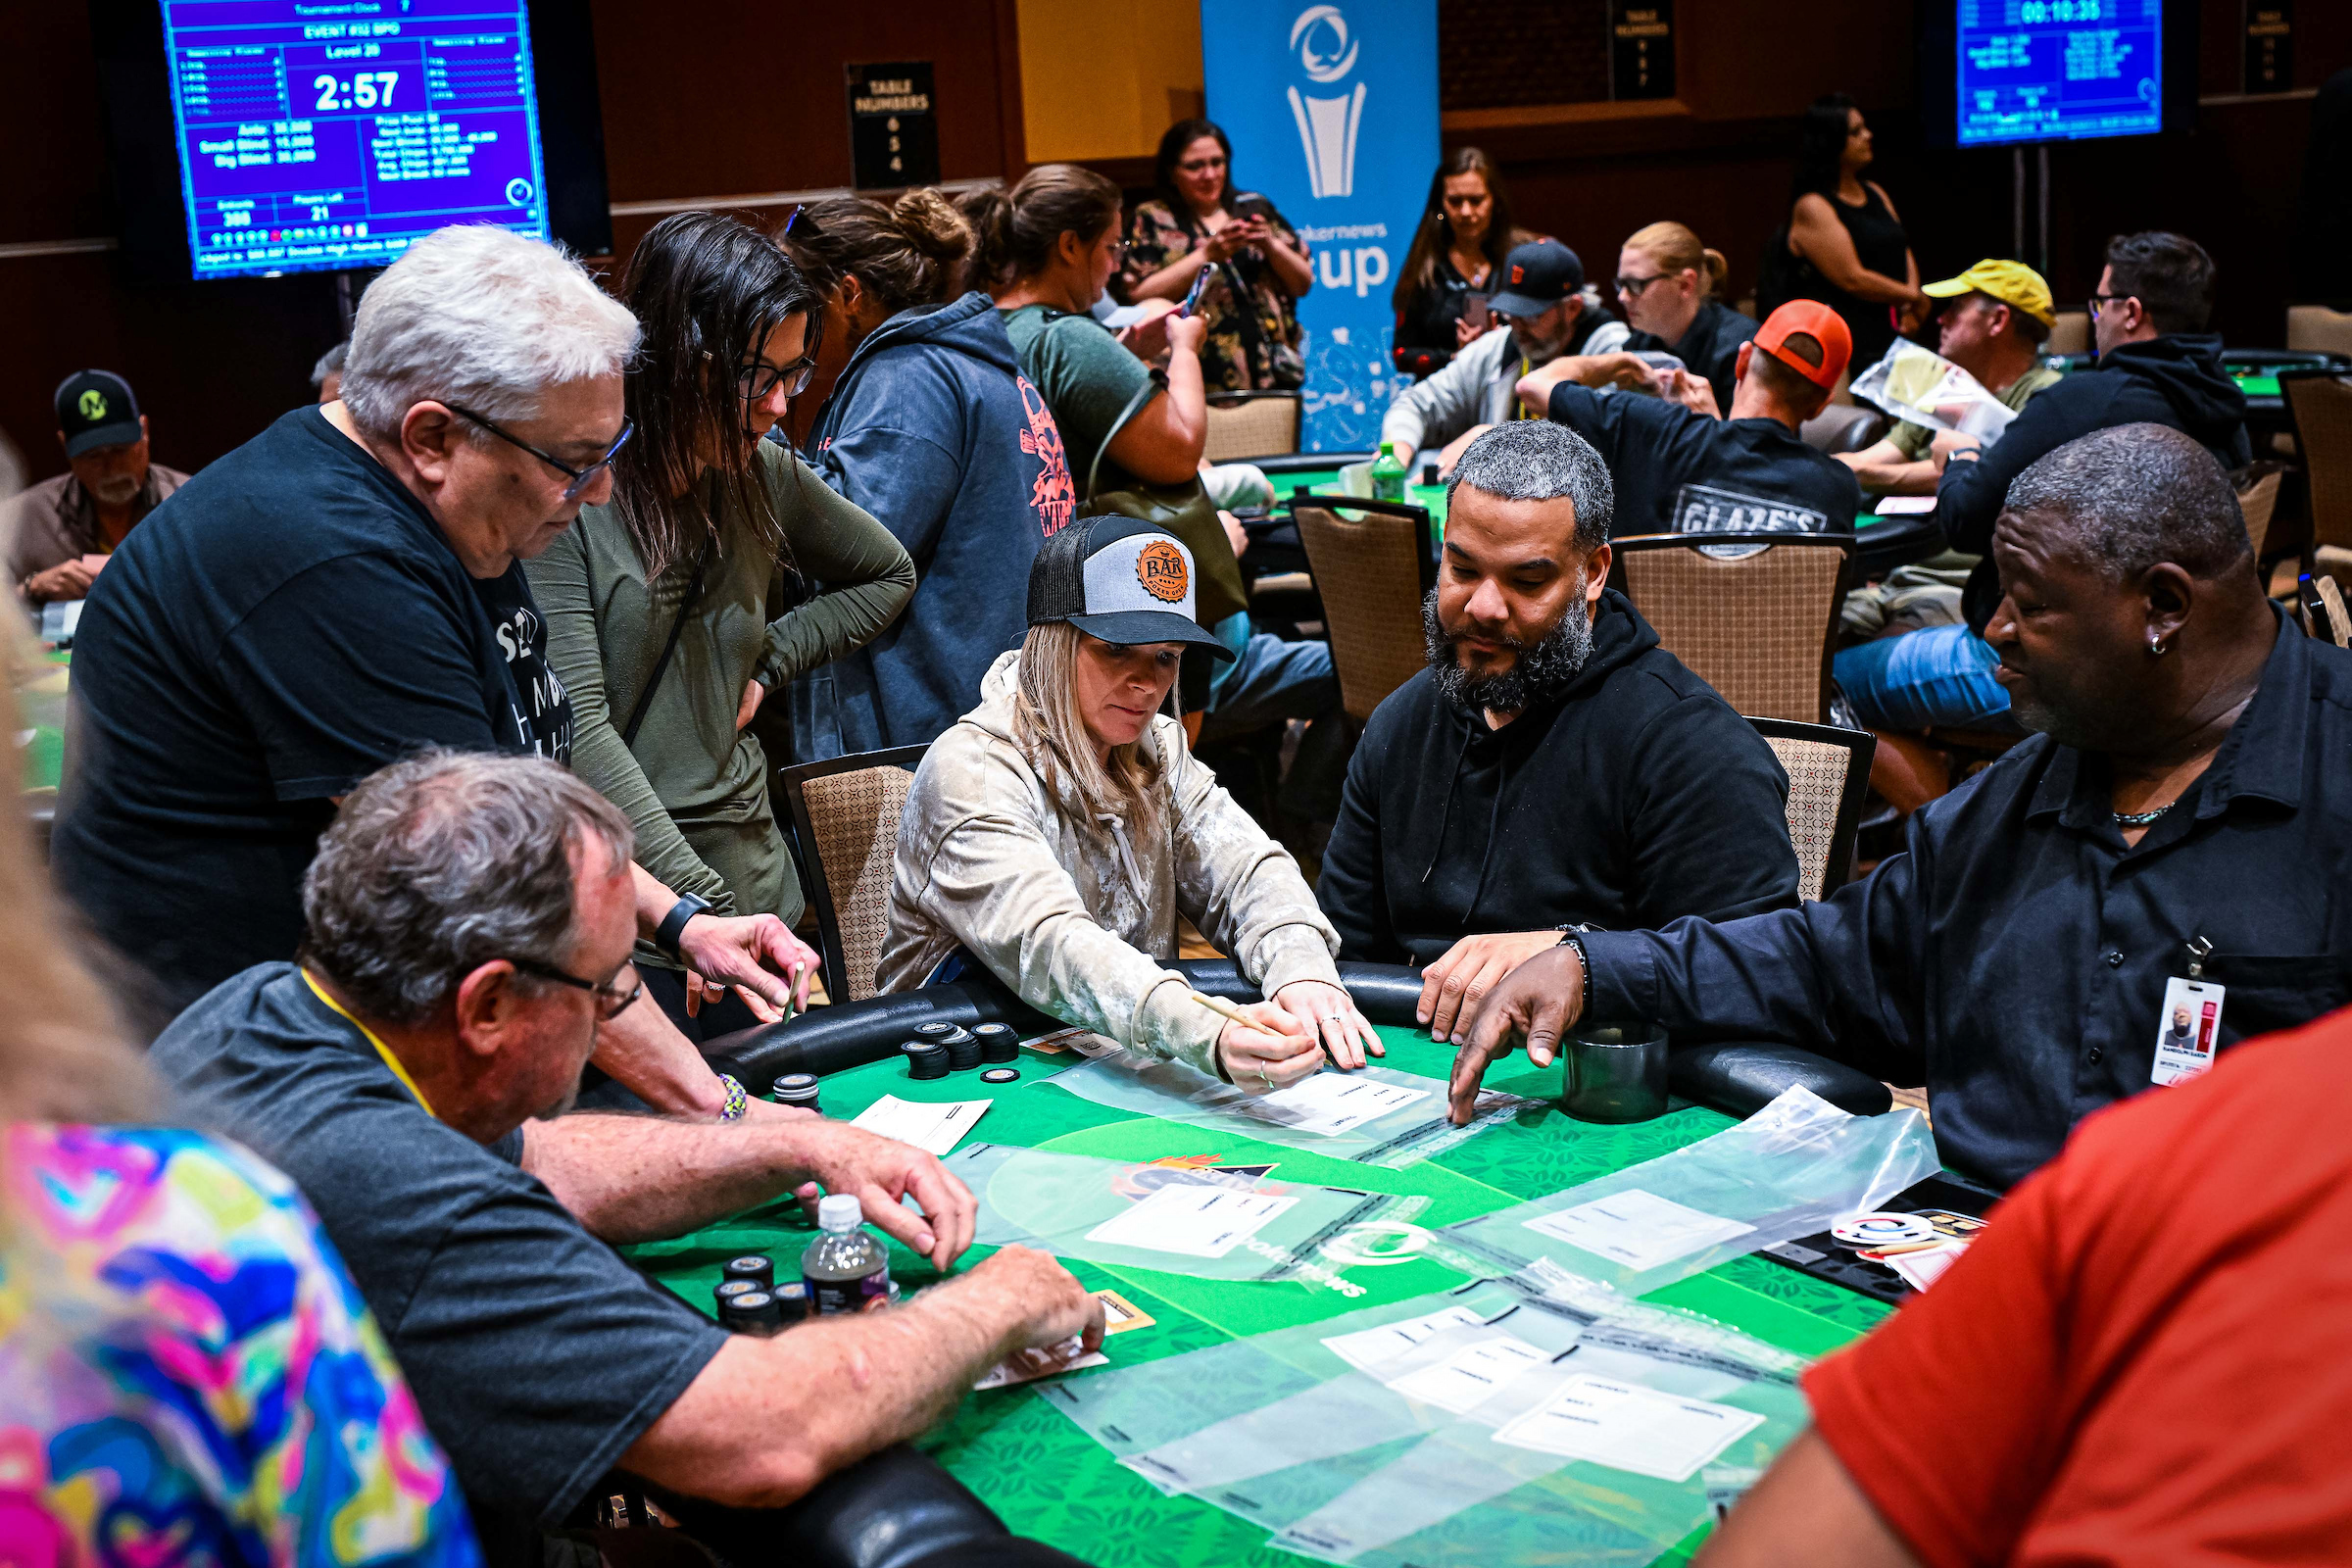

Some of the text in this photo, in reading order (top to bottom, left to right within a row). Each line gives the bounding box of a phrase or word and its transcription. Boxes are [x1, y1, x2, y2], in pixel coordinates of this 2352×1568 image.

[314, 71, 400, 112] 2:57
[869, 79, 912, 95] TABLE
[855, 95, 929, 113] NUMBERS
[1296, 221, 1388, 243] okernews
[1308, 245, 1390, 298] up
[1146, 557, 1184, 579] BAR
[1148, 579, 1184, 597] POKER OPEN
